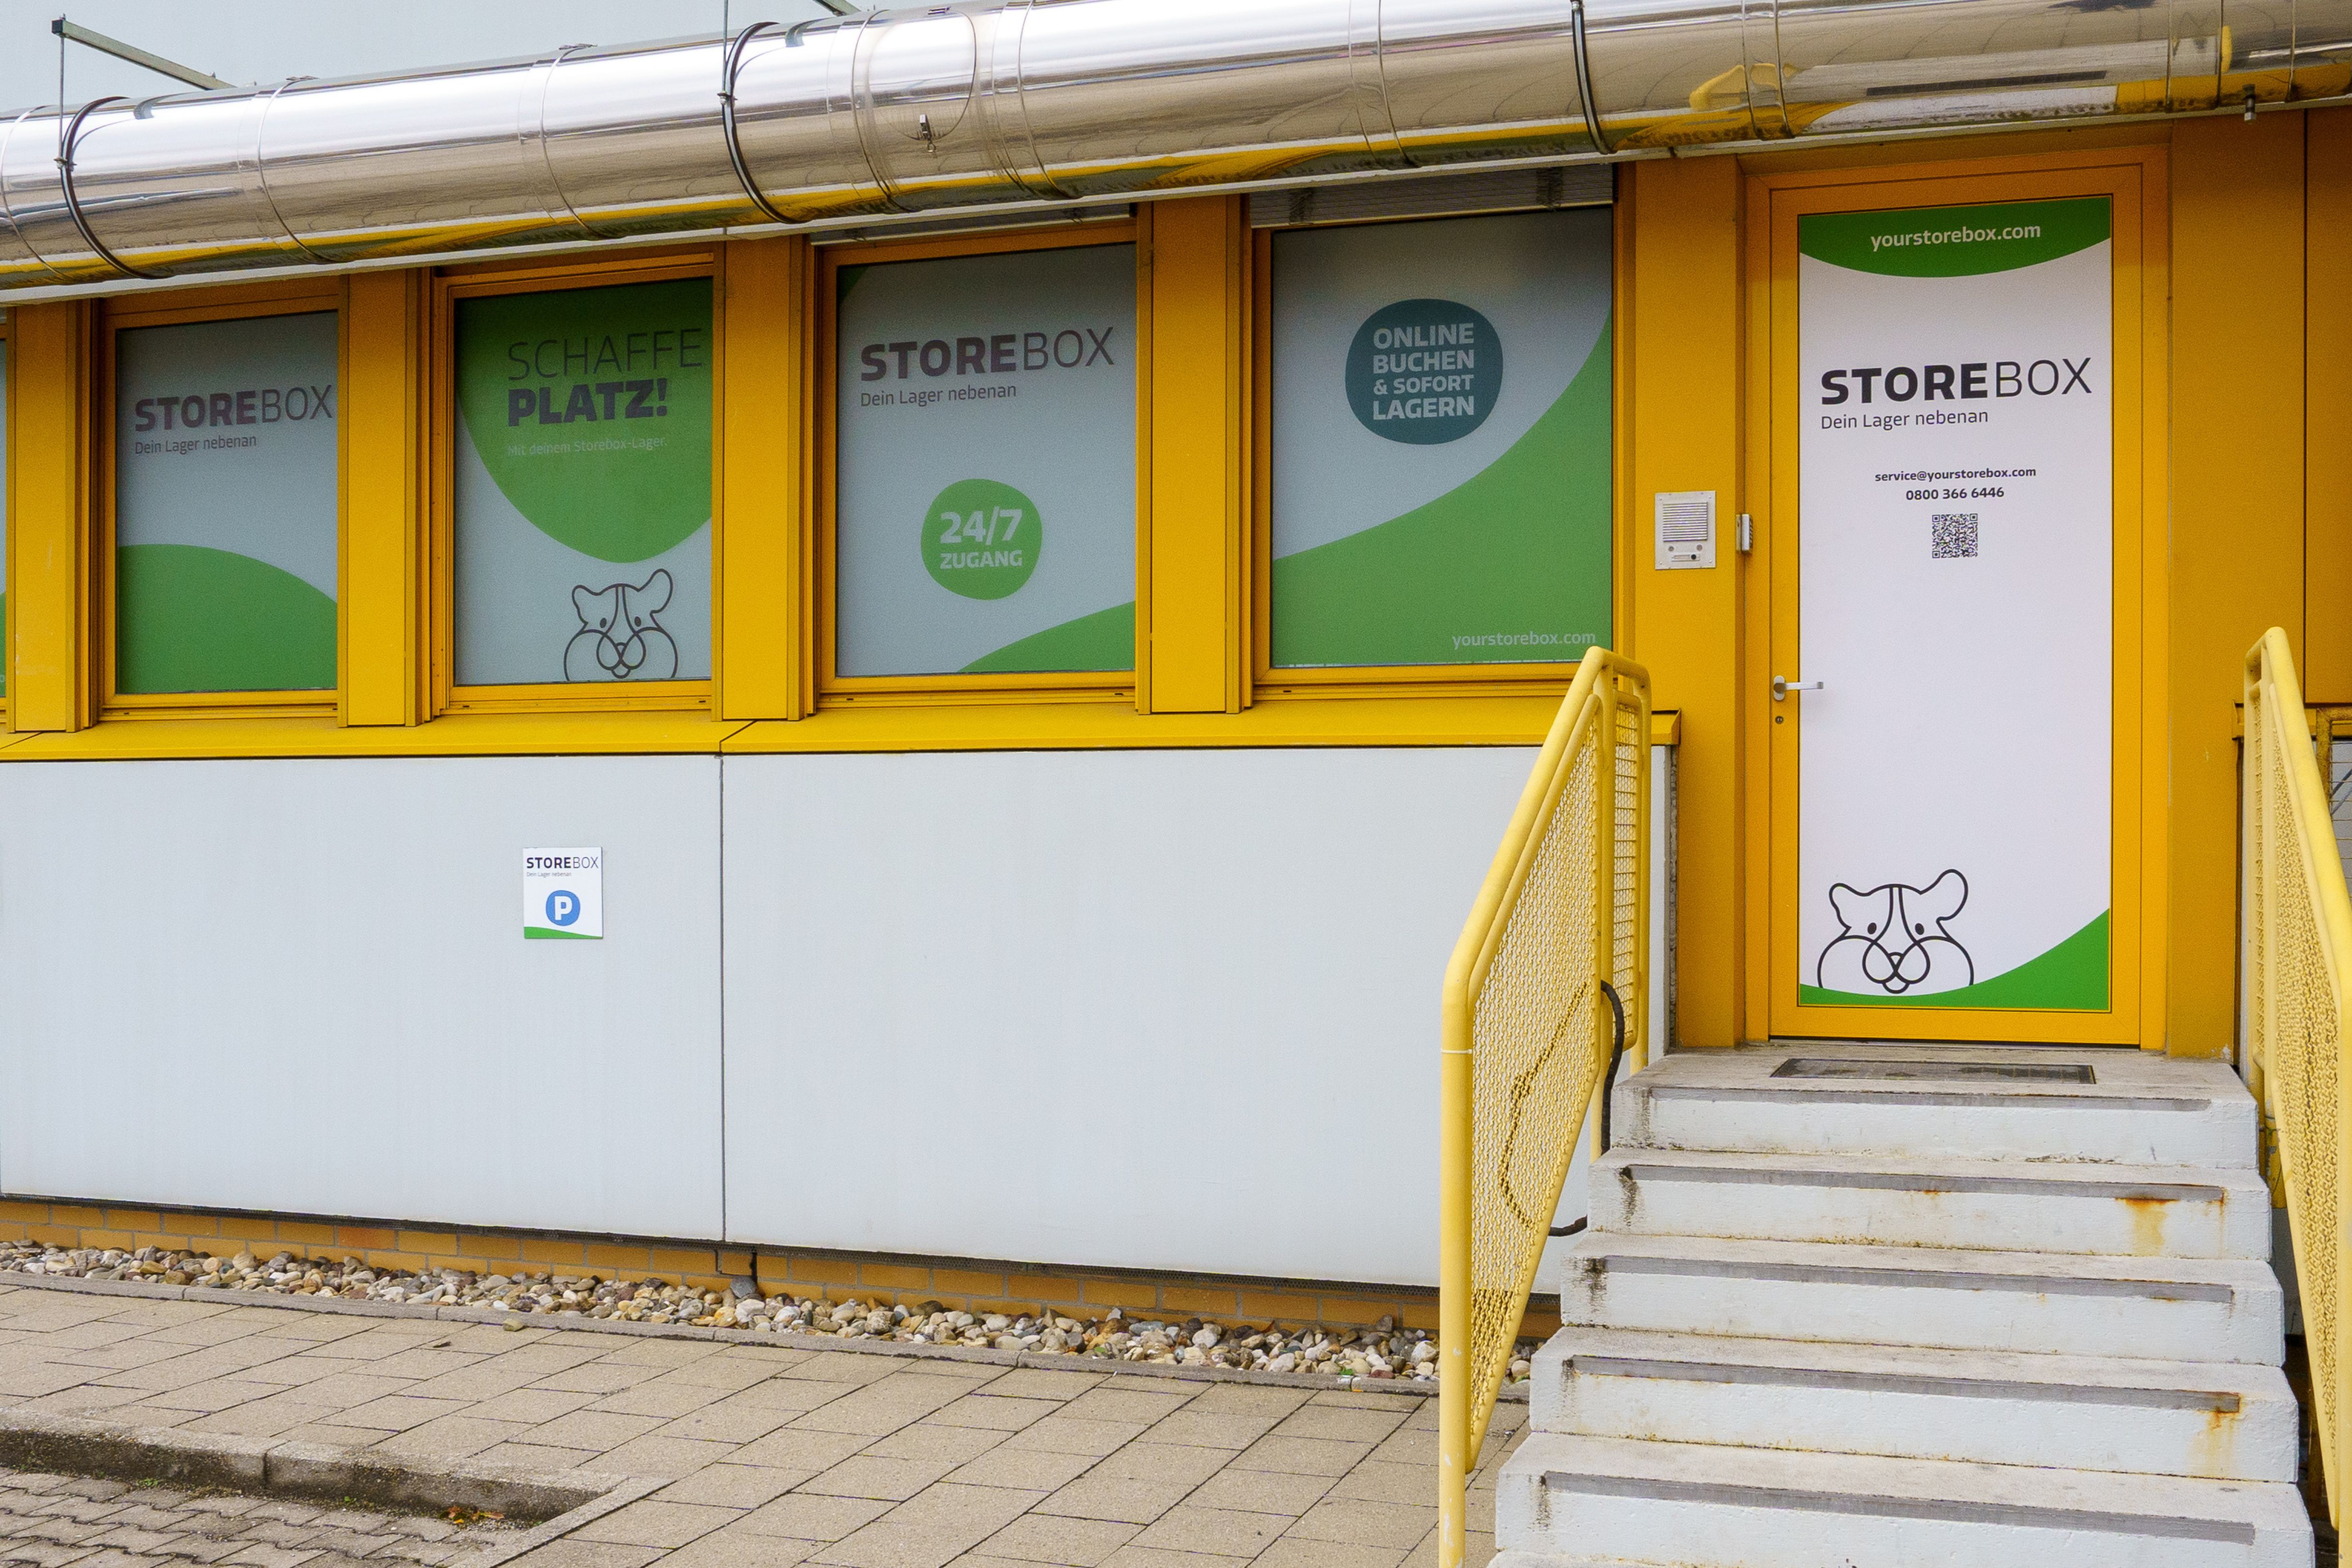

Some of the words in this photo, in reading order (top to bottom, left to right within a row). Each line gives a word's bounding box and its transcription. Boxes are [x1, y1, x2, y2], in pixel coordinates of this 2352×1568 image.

[1870, 225, 2041, 252] yourstorebox.com
[1373, 323, 1475, 349] ONLINE
[508, 328, 702, 381] SCHAFFE
[860, 327, 1115, 381] STOREBOX
[1373, 349, 1475, 374] BUCHEN
[1373, 379, 1389, 395] &
[1393, 374, 1475, 394] SOFORT
[1821, 357, 2092, 405] STOREBOX
[508, 377, 667, 426] PLATZ!
[861, 392, 894, 407] Dein
[899, 389, 943, 407] Lager
[948, 384, 1017, 401] nebenan
[1373, 395, 1475, 420] LAGERN
[135, 385, 333, 432] STOREBOX
[1821, 414, 1857, 429] Dein
[1863, 413, 1910, 431] Lager
[1915, 409, 1989, 425] nebenan
[135, 441, 162, 454] Dein
[165, 438, 200, 455] Lager
[203, 436, 257, 449] nebenan
[508, 444, 526, 456] Mit
[529, 442, 571, 455] deinem
[1875, 468, 2036, 482] service@yourstorebox.com
[1906, 489, 1939, 500] 0800
[1943, 488, 1967, 499] 366
[1971, 487, 2005, 498] 6446
[940, 506, 1023, 545] 24/7
[940, 549, 1023, 570] ZUGANG
[1452, 631, 1596, 650] yourstorebox.com
[527, 857, 599, 869] STOREBOX
[555, 895, 573, 921] P
